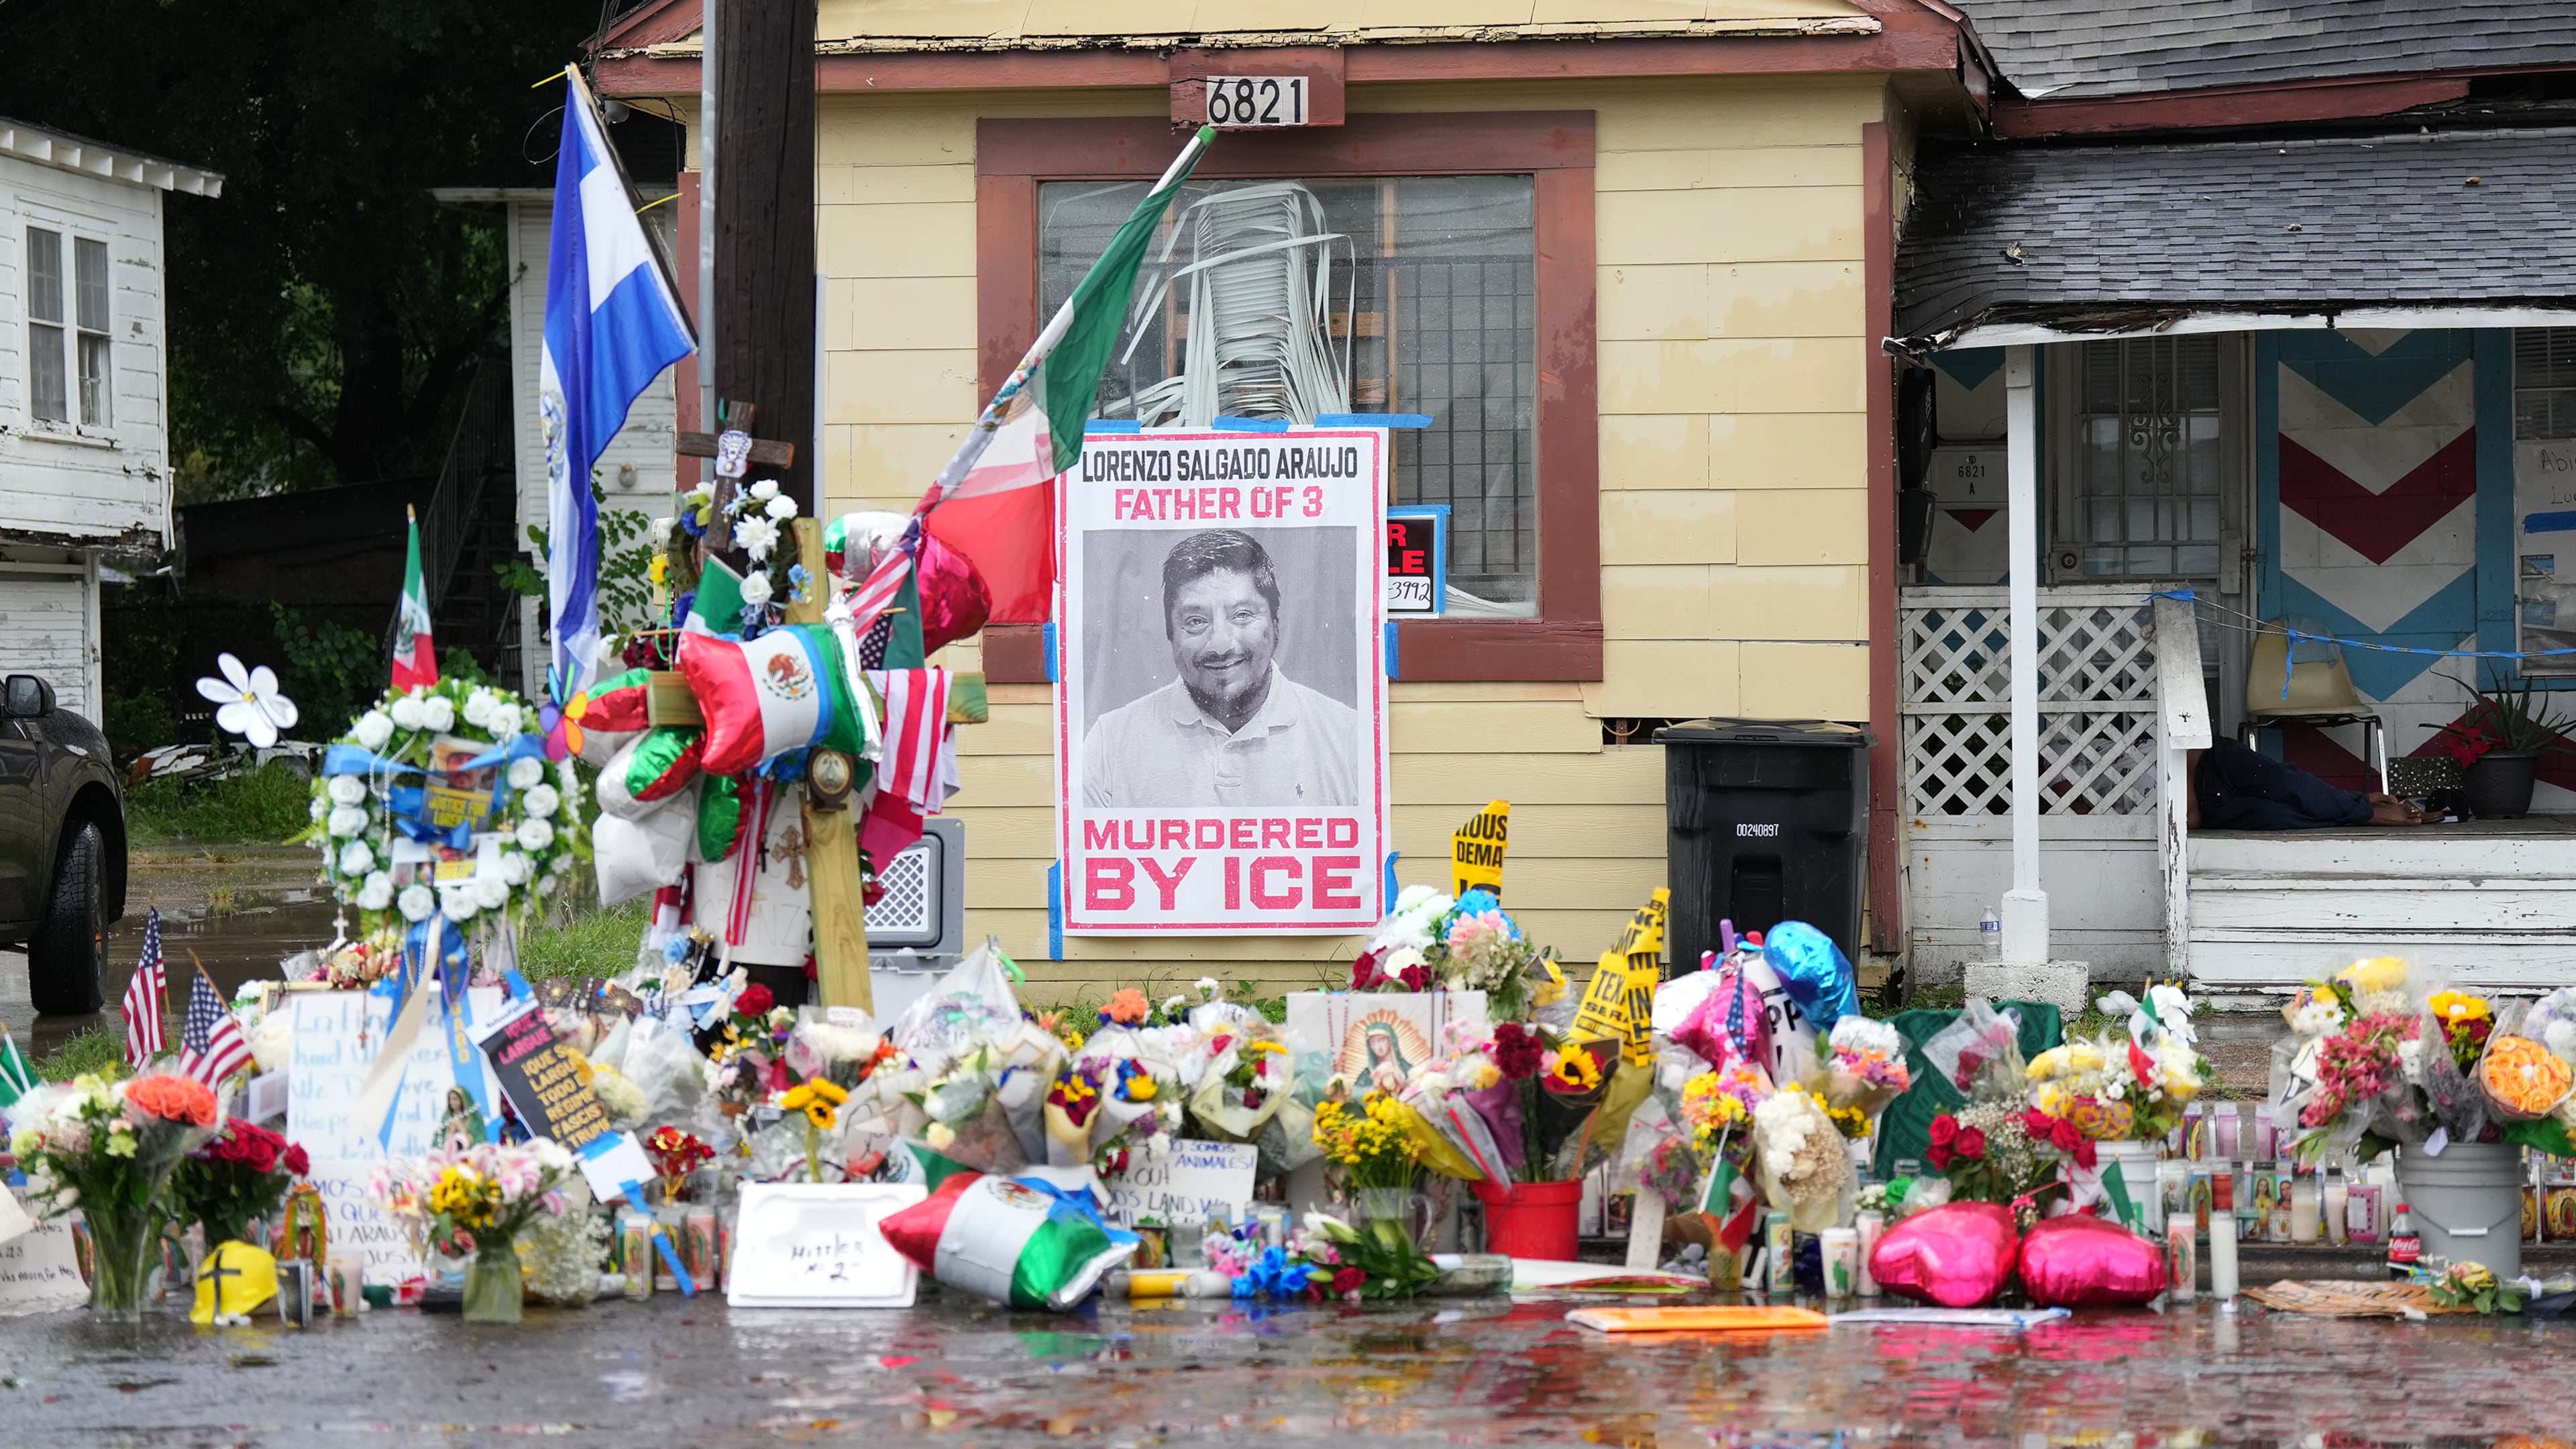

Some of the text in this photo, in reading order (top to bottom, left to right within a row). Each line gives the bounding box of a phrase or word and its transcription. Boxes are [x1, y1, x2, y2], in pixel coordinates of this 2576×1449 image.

[1208, 78, 1301, 124] 6821
[1082, 447, 1358, 482] LORENZO SALGADO ARAUJO
[1958, 465, 1985, 478] 6821
[1115, 486, 1323, 521] FATHER OF 3
[1969, 482, 1975, 494] A
[1083, 818, 1359, 850] MURDERED
[1736, 823, 1780, 837] 00240897
[1085, 855, 1361, 911] BY ICE
